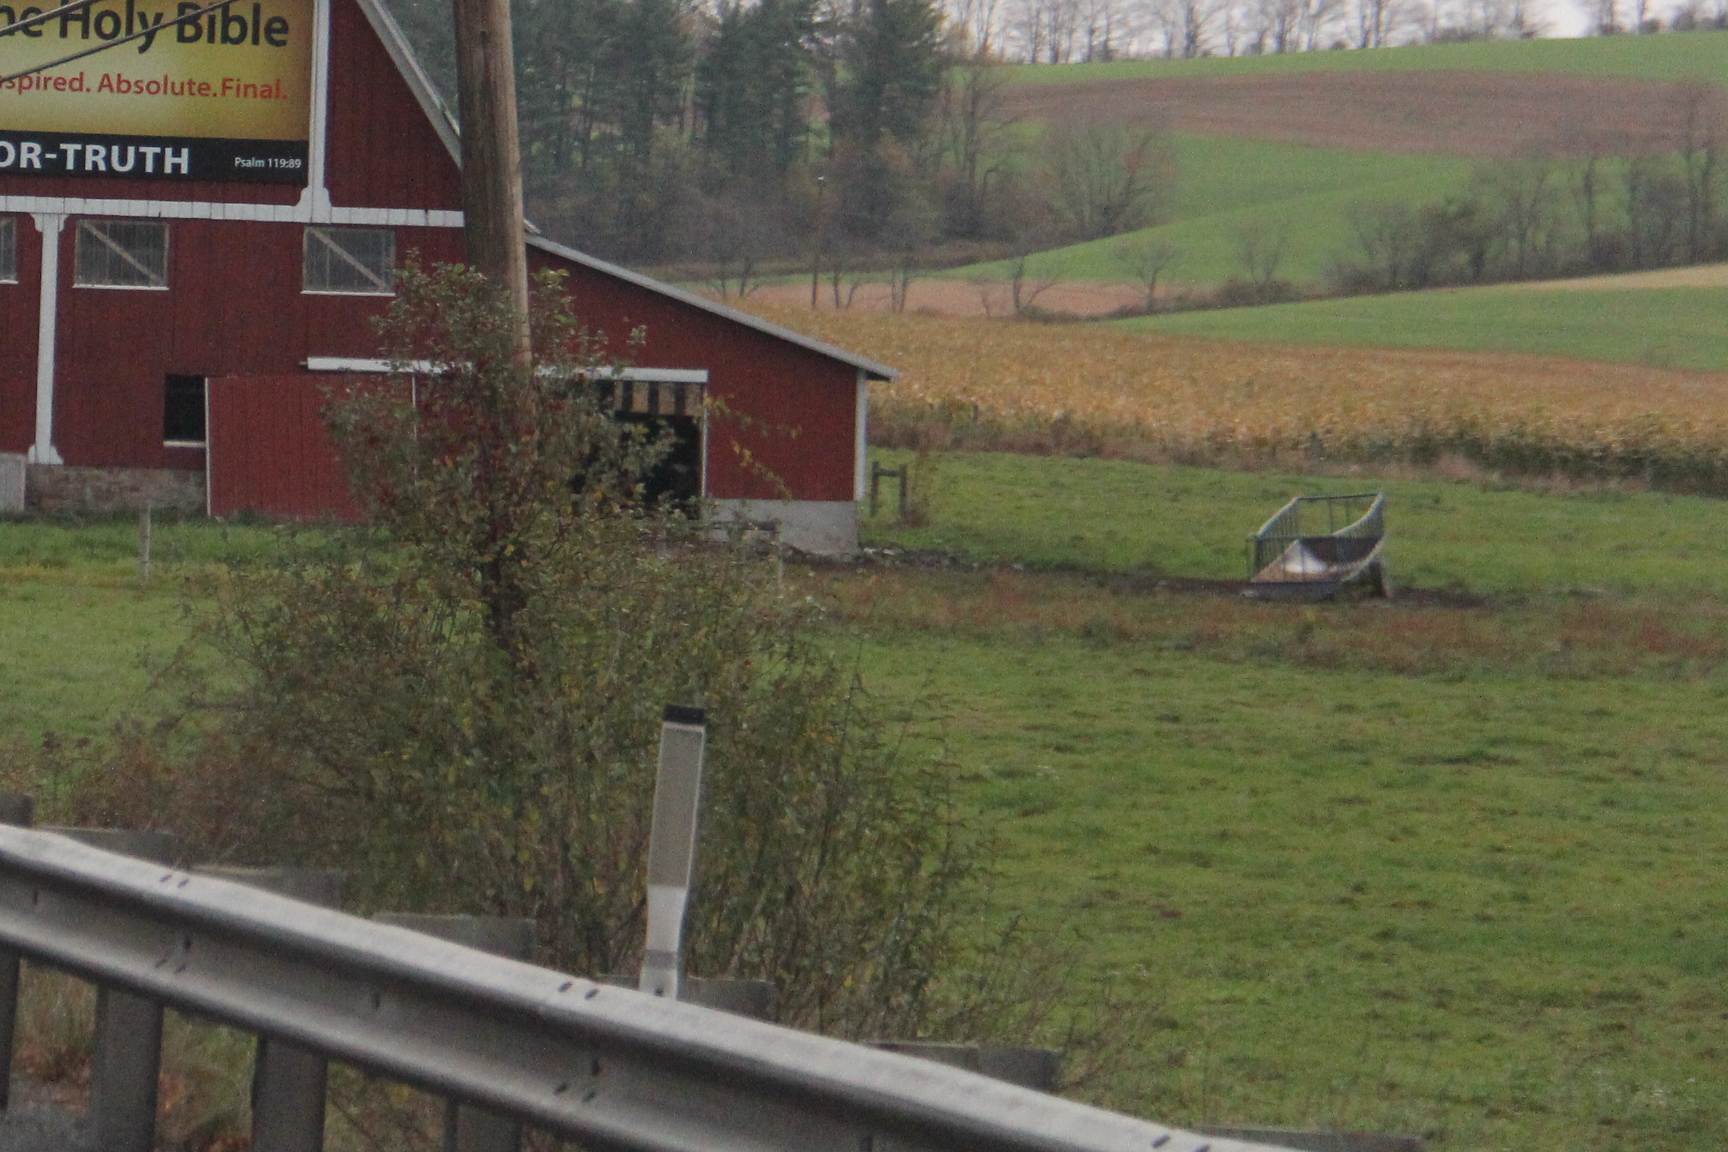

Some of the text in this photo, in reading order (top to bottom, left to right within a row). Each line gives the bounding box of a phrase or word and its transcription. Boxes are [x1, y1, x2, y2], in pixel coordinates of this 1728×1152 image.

[176, 1, 289, 47] Bible
[97, 72, 217, 97] Absolute.
[221, 77, 288, 100] Final.
[234, 156, 302, 169] Psalm 119:89
